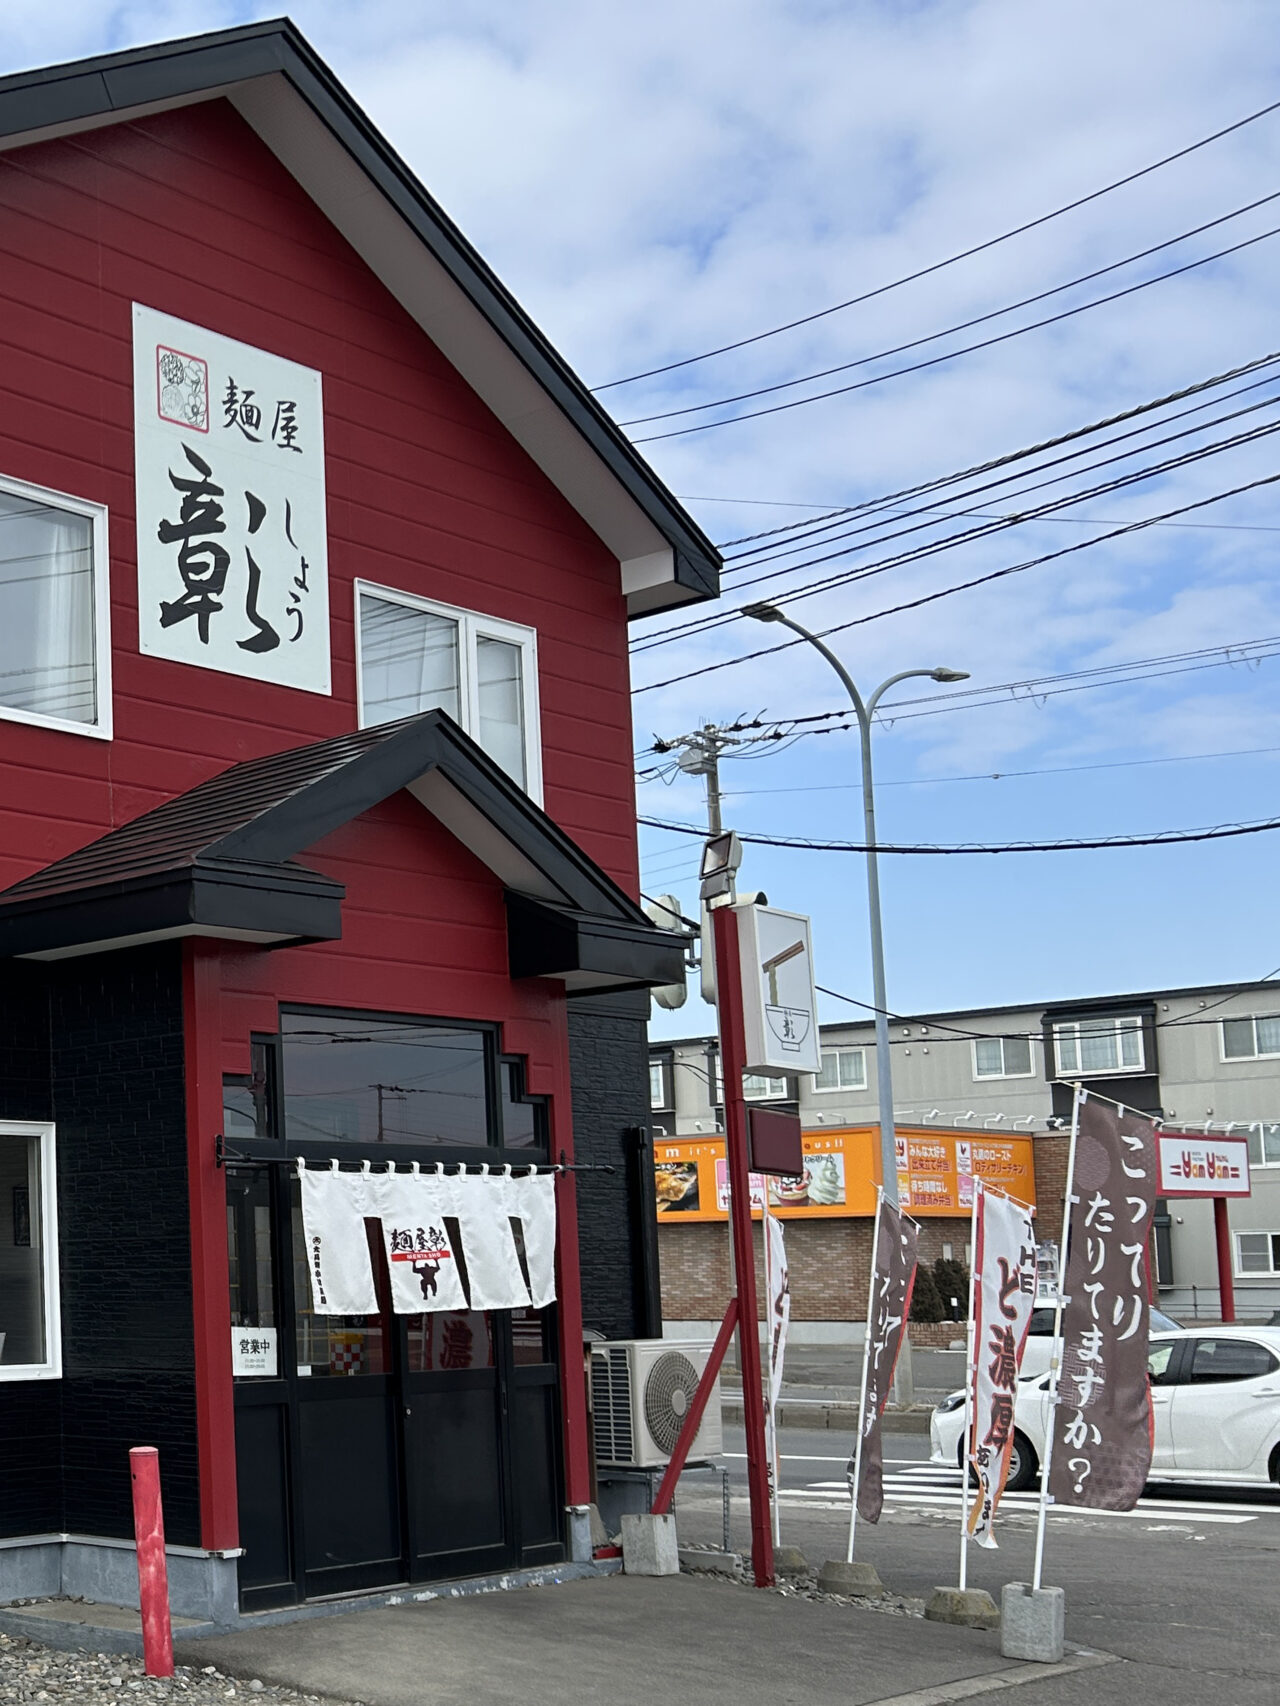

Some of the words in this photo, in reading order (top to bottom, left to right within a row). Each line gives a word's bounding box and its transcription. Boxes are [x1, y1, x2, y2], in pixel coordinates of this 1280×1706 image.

[222, 376, 303, 454] 麺屋
[157, 442, 281, 654] 彰
[284, 497, 310, 643] しょう
[1019, 1219, 1036, 1295] THE
[1113, 1135, 1149, 1341] こってり
[239, 1338, 270, 1355] 営業中
[983, 1256, 1021, 1459] ど濃厚
[1063, 1190, 1116, 1494] たりてますか?
